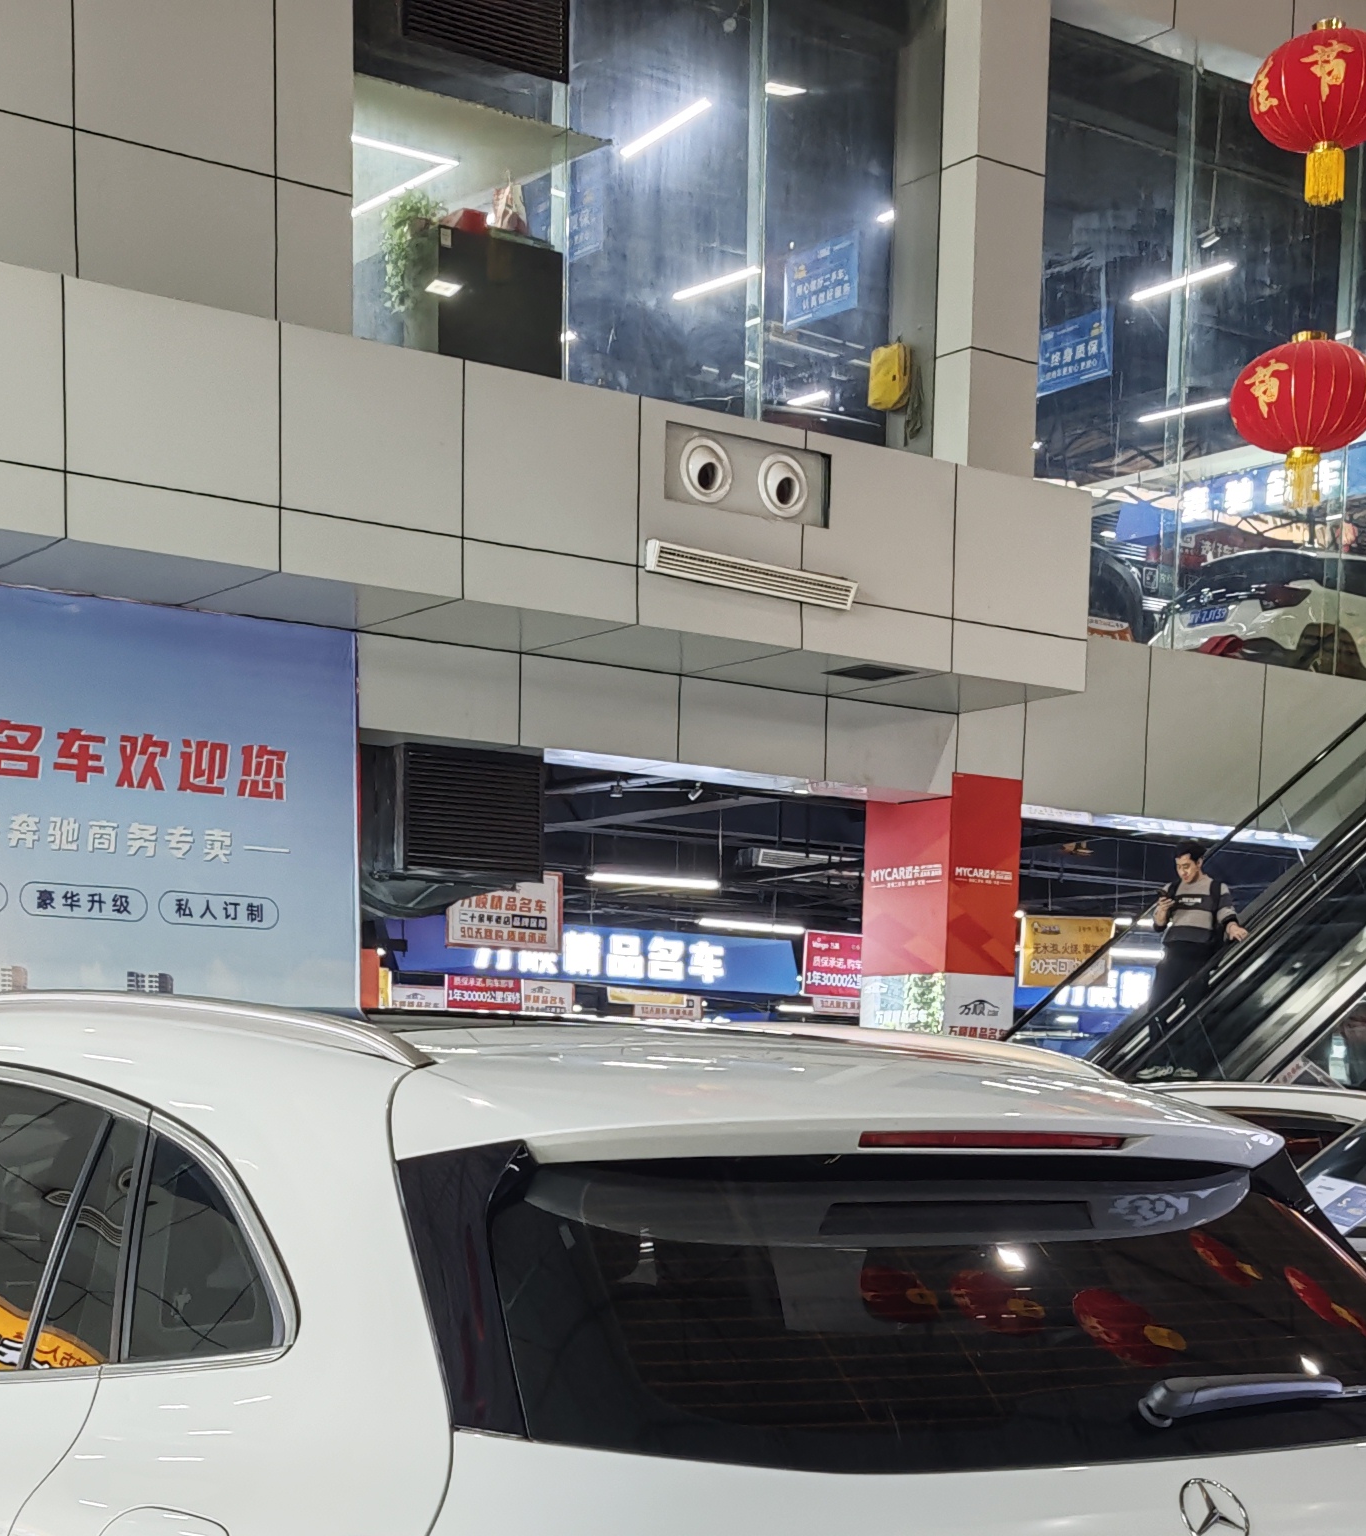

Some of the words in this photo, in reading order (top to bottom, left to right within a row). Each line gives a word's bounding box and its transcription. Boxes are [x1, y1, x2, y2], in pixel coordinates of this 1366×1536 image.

[35, 886, 134, 917] 豪华升级
[173, 900, 266, 925] 私人订制
